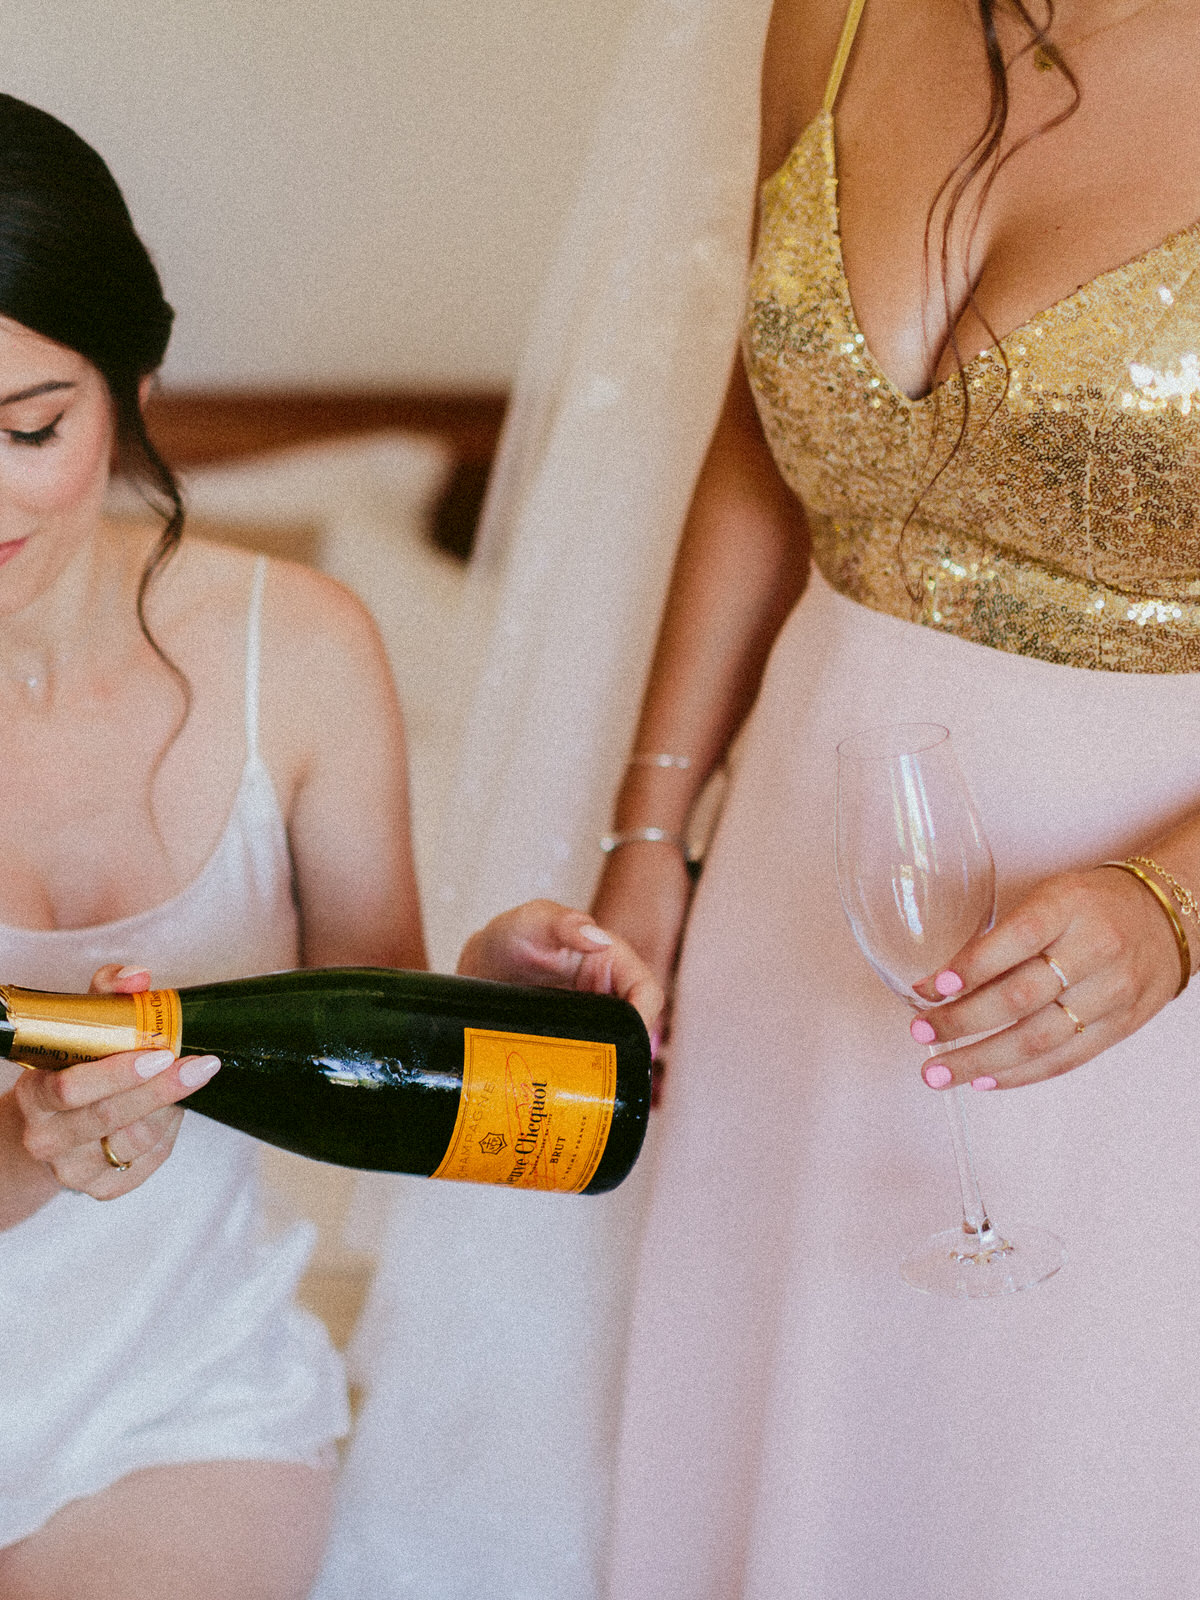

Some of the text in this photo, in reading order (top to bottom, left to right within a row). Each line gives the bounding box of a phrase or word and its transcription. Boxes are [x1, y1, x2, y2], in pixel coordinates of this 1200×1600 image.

[151, 1009, 164, 1038] Veuve
[72, 1053, 98, 1062] euve
[457, 1081, 495, 1180] CHAMPAGNE
[514, 1081, 548, 1155] Clicquot
[549, 1136, 567, 1165] BRUT
